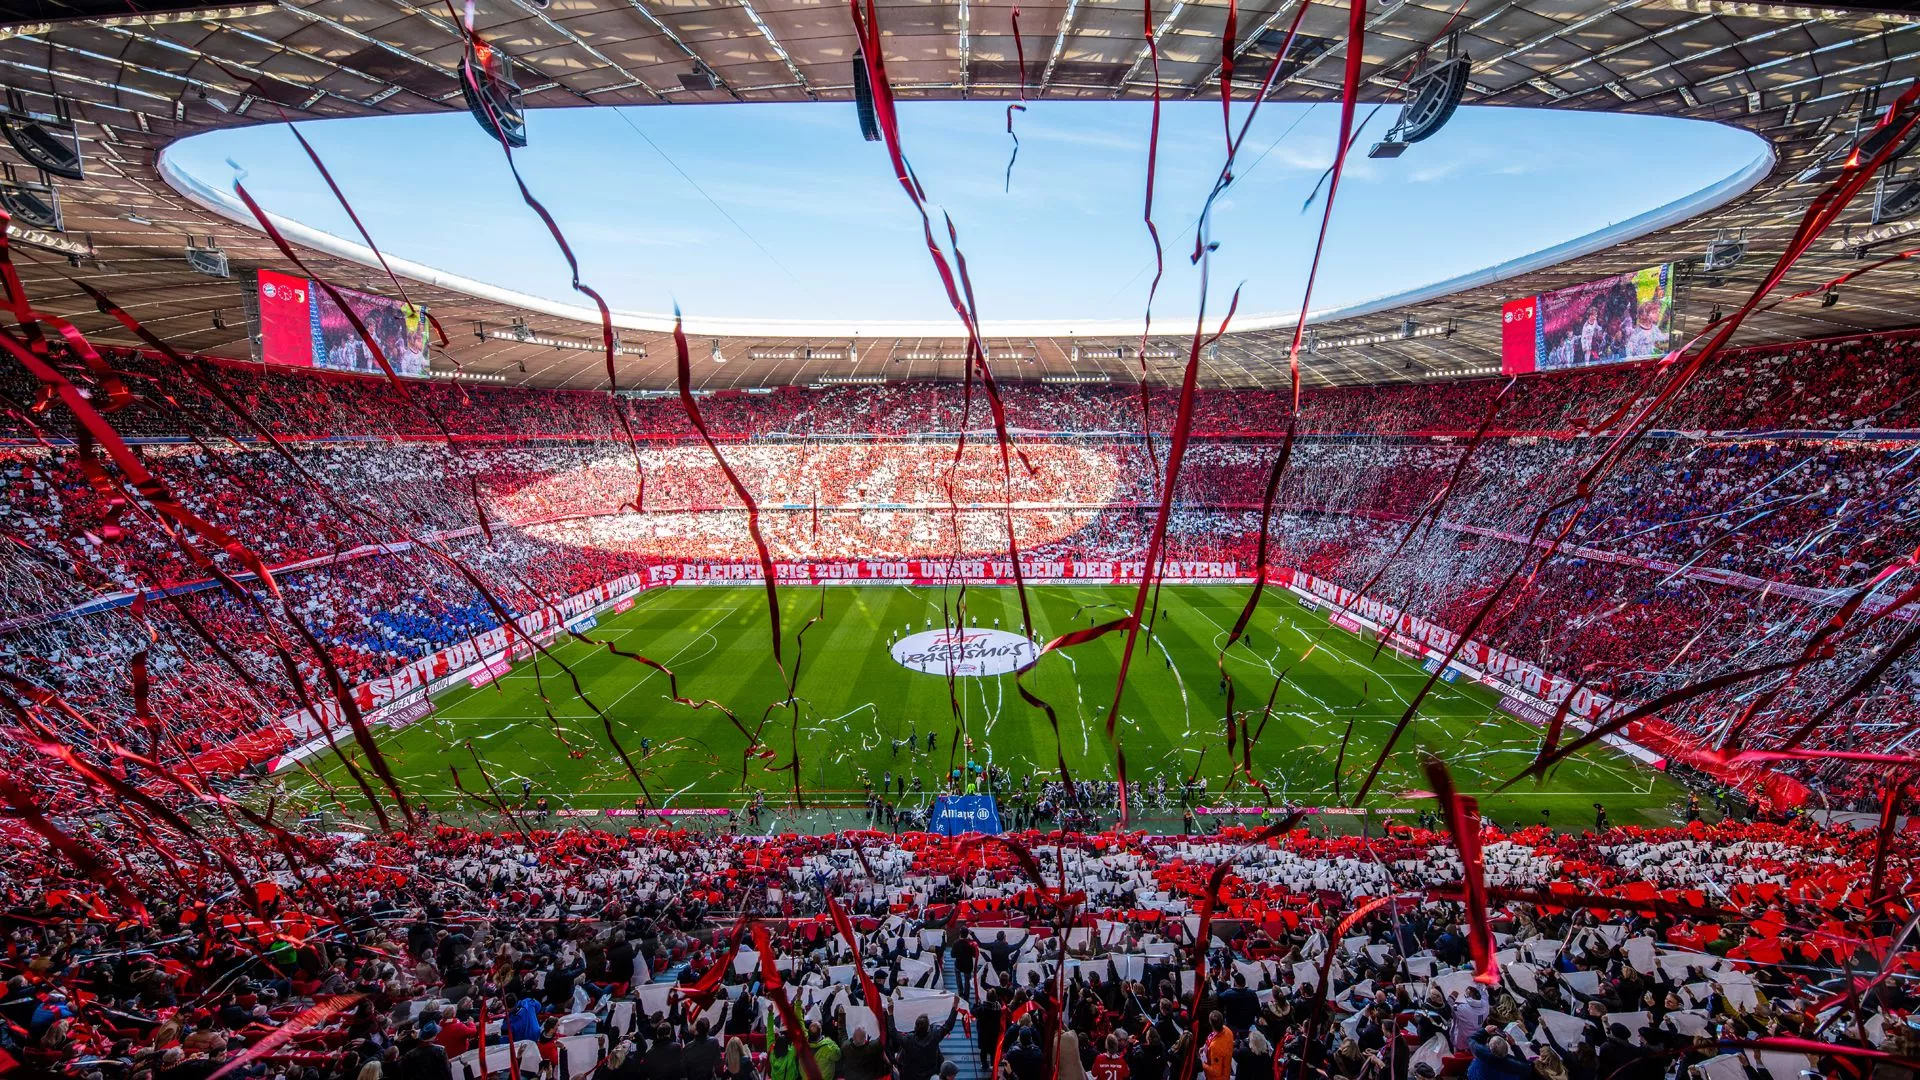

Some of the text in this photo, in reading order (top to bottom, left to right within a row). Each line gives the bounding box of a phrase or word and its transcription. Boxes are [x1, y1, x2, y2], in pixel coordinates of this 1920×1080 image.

[648, 564, 677, 582] ES
[815, 562, 859, 578] ZUM
[866, 562, 914, 578] TOD.
[921, 561, 985, 578] UNSER
[992, 561, 1065, 578] VEREIN
[1073, 561, 1113, 578] DER
[1121, 561, 1146, 578] FC
[369, 654, 438, 707] SEIT
[606, 572, 640, 599] WIRD
[1293, 570, 1310, 590] IN
[1310, 576, 1340, 604] DEN
[1486, 646, 1545, 696] UND
[1423, 658, 1447, 678] Alliz
[941, 809, 975, 819] Allianz
